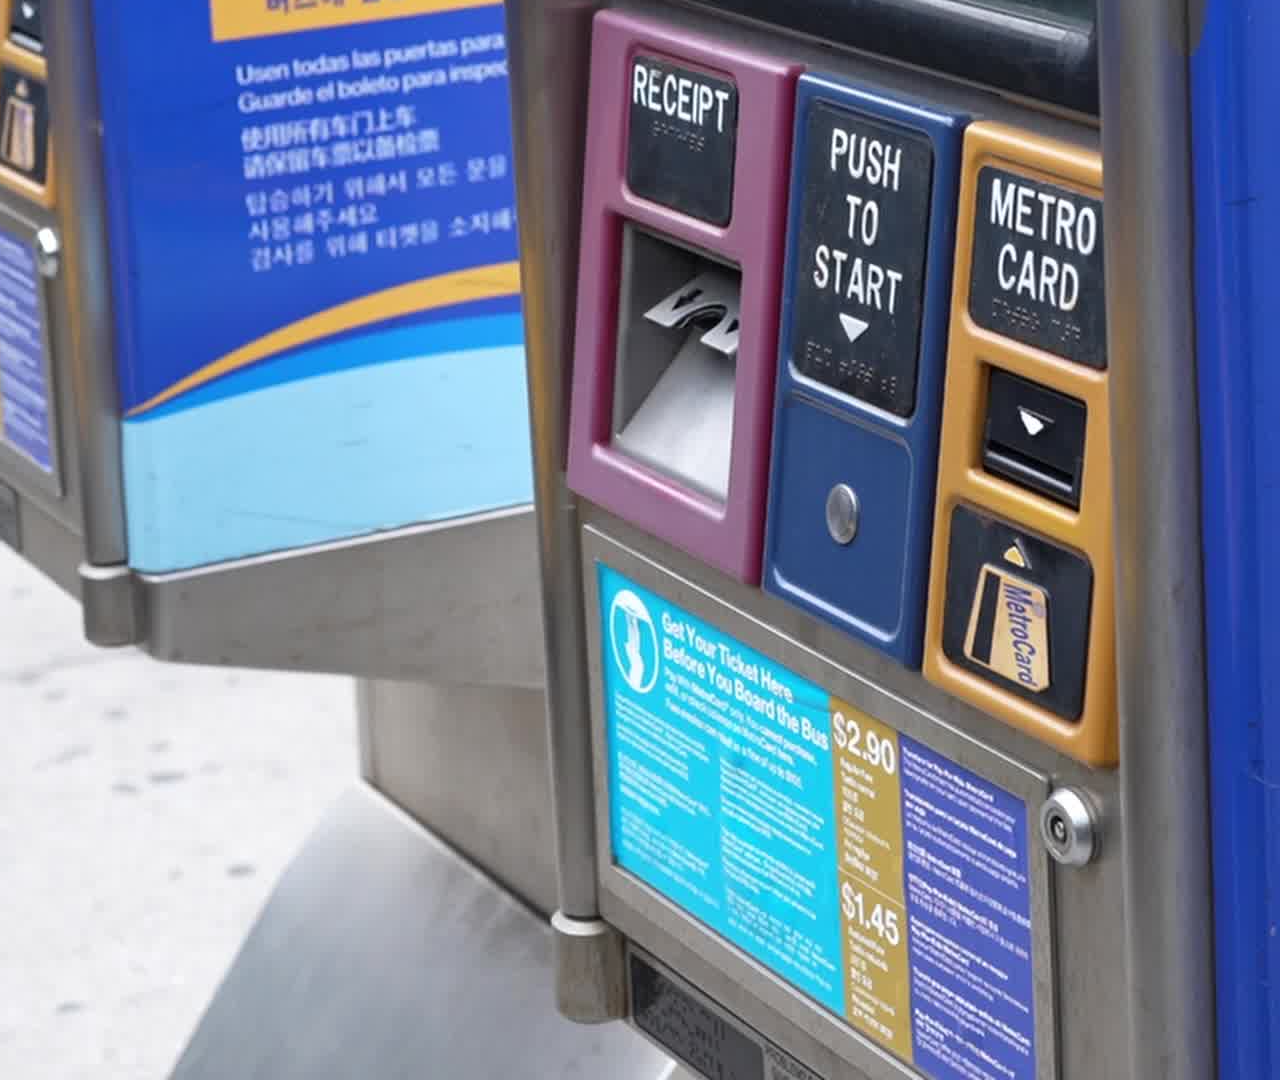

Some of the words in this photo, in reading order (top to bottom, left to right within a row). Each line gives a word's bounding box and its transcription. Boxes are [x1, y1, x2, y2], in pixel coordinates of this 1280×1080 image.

[236, 61, 289, 86] Usen
[293, 54, 350, 78] todas
[351, 48, 381, 69] las
[384, 39, 458, 67] puertas
[461, 33, 505, 57] para
[238, 84, 313, 114] Guarde
[316, 81, 335, 103] el
[338, 75, 399, 100] boleto
[402, 67, 447, 92] para
[632, 64, 730, 132] RECEIPT
[831, 128, 903, 191] PUSH
[846, 195, 879, 247] TO
[990, 178, 1097, 256] METRO
[813, 245, 903, 315] START
[998, 244, 1080, 311] CARD
[661, 611, 685, 636] Get
[687, 622, 718, 658] Your
[719, 641, 759, 684] Ticket
[761, 669, 793, 704] Here
[1003, 582, 1039, 689] MetroCard
[663, 637, 705, 679] Before
[707, 661, 733, 696] You
[735, 678, 775, 716] Board
[776, 703, 800, 733] the
[801, 715, 829, 751] Bus
[833, 711, 896, 775] $2.90
[841, 881, 900, 947] $1.45
